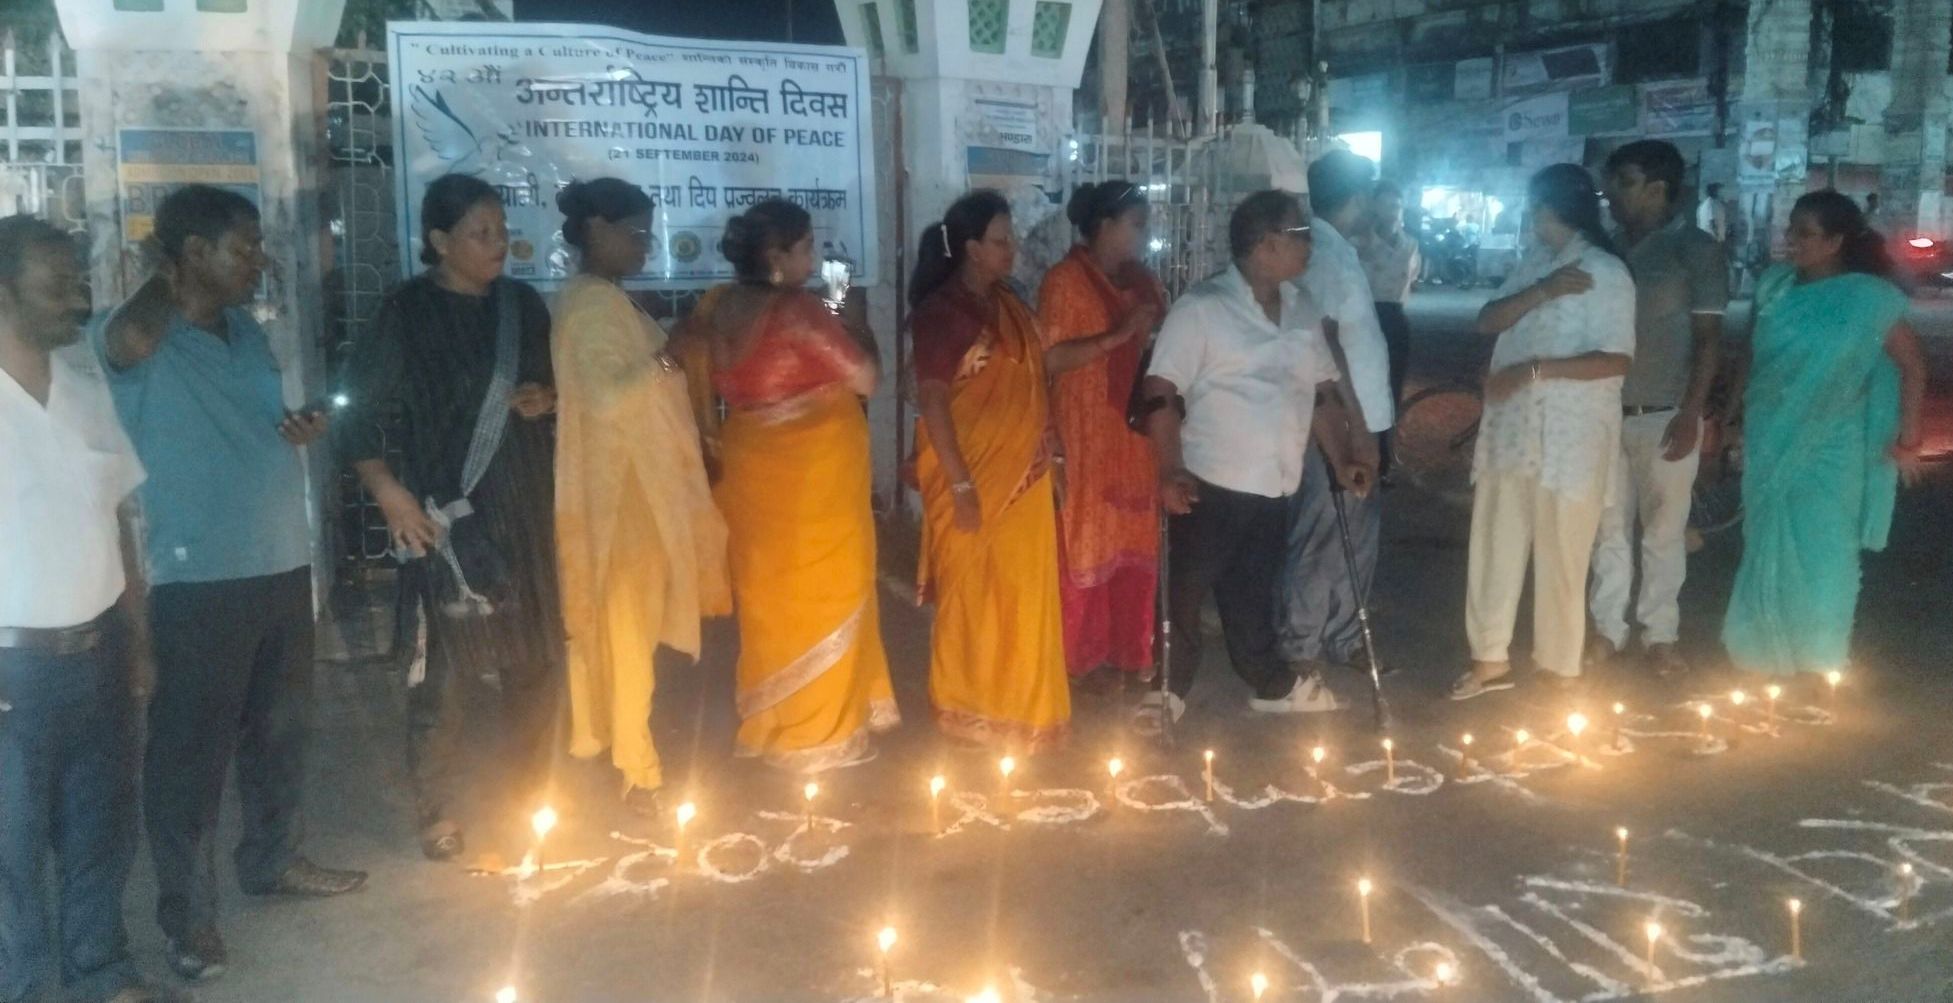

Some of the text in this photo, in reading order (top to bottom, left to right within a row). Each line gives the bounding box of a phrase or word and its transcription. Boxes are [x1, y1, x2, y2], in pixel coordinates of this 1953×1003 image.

[525, 47, 533, 56] a
[539, 46, 598, 57] Culture
[693, 74, 769, 115] शान्ति
[779, 78, 848, 119] दिवस
[526, 119, 847, 148] INTERNATIONAL DAY OF PEACE
[608, 149, 760, 165] (21 SEPTEMBER 2024)
[649, 185, 682, 209] तथा
[688, 175, 717, 209] दिप
